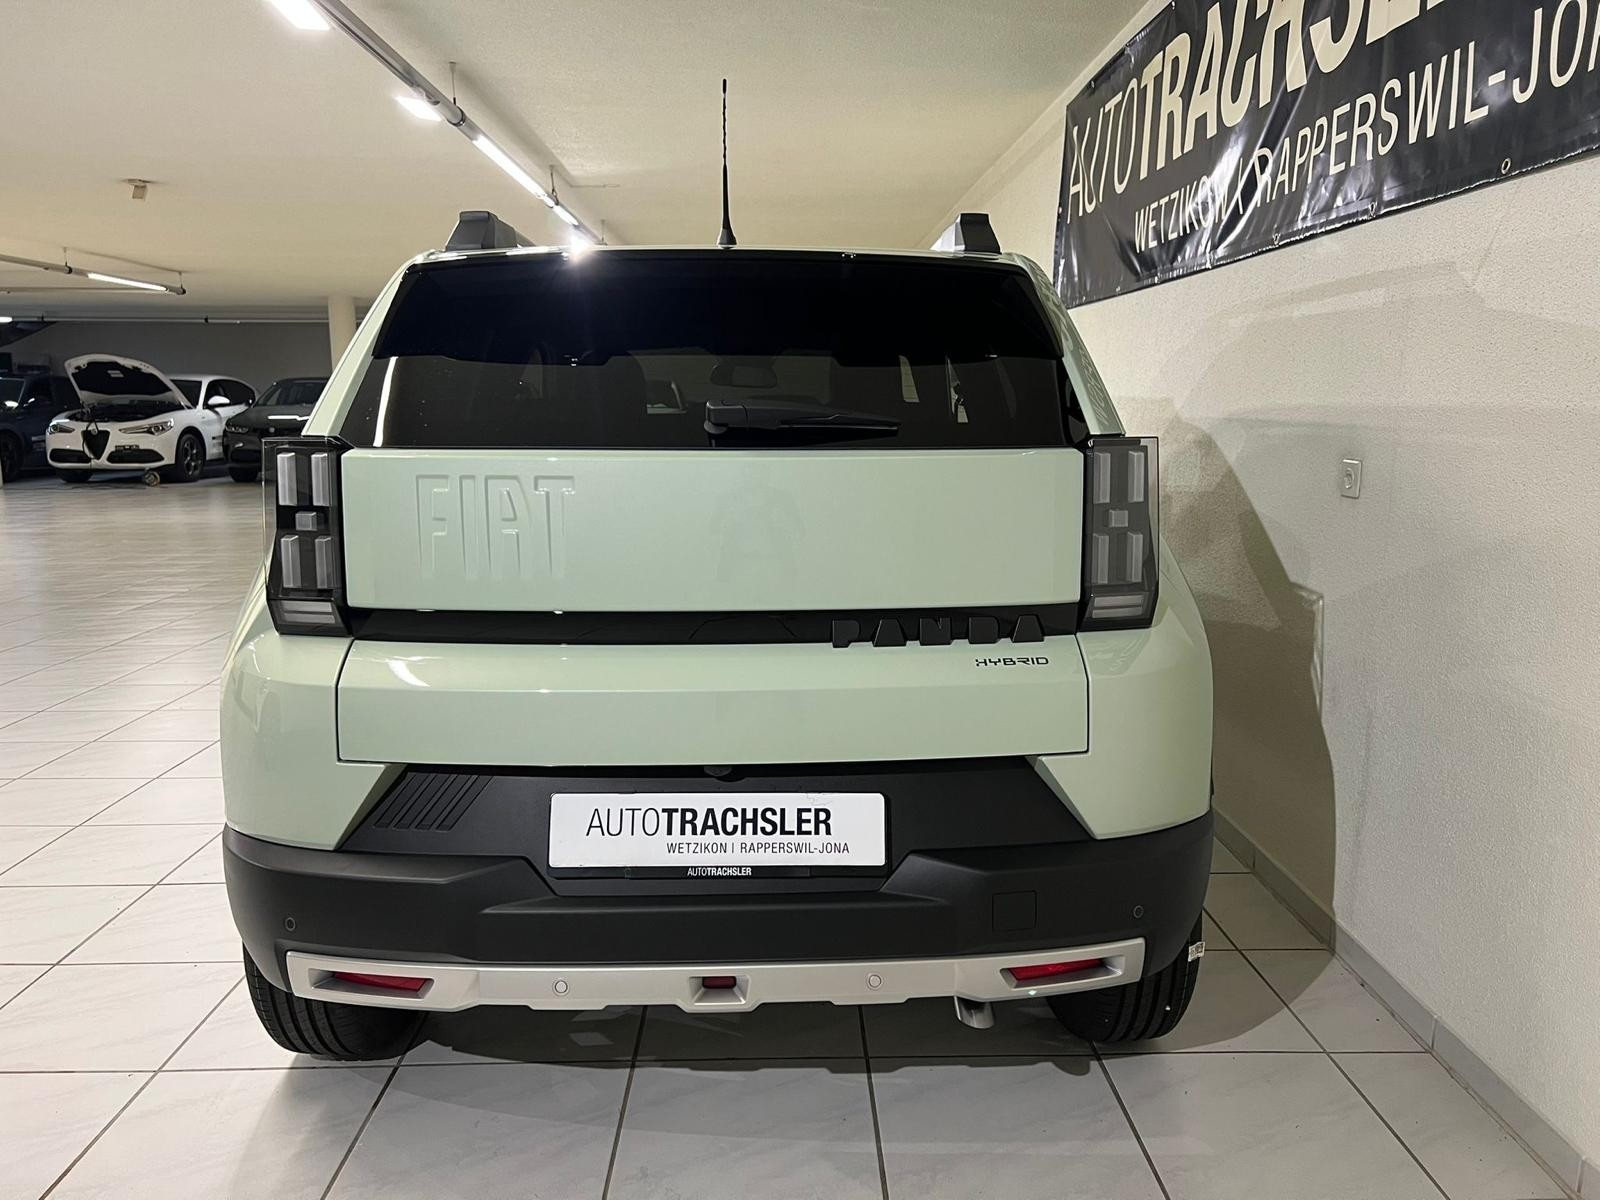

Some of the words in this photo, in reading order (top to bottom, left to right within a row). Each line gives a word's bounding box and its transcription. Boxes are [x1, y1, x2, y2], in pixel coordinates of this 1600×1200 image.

[1067, 0, 1445, 224] AUTOTRACH
[1135, 175, 1229, 253] WETZIKON
[416, 475, 575, 580] FIAT
[832, 614, 1044, 648] PANDA
[975, 656, 1049, 667] HYBRID
[586, 807, 832, 837] AUTOTRACHSLER
[666, 842, 728, 855] WETZIKON
[740, 842, 850, 854] RAPPERSWIL-JONA
[687, 867, 752, 876] AUTOTRACHSLER
